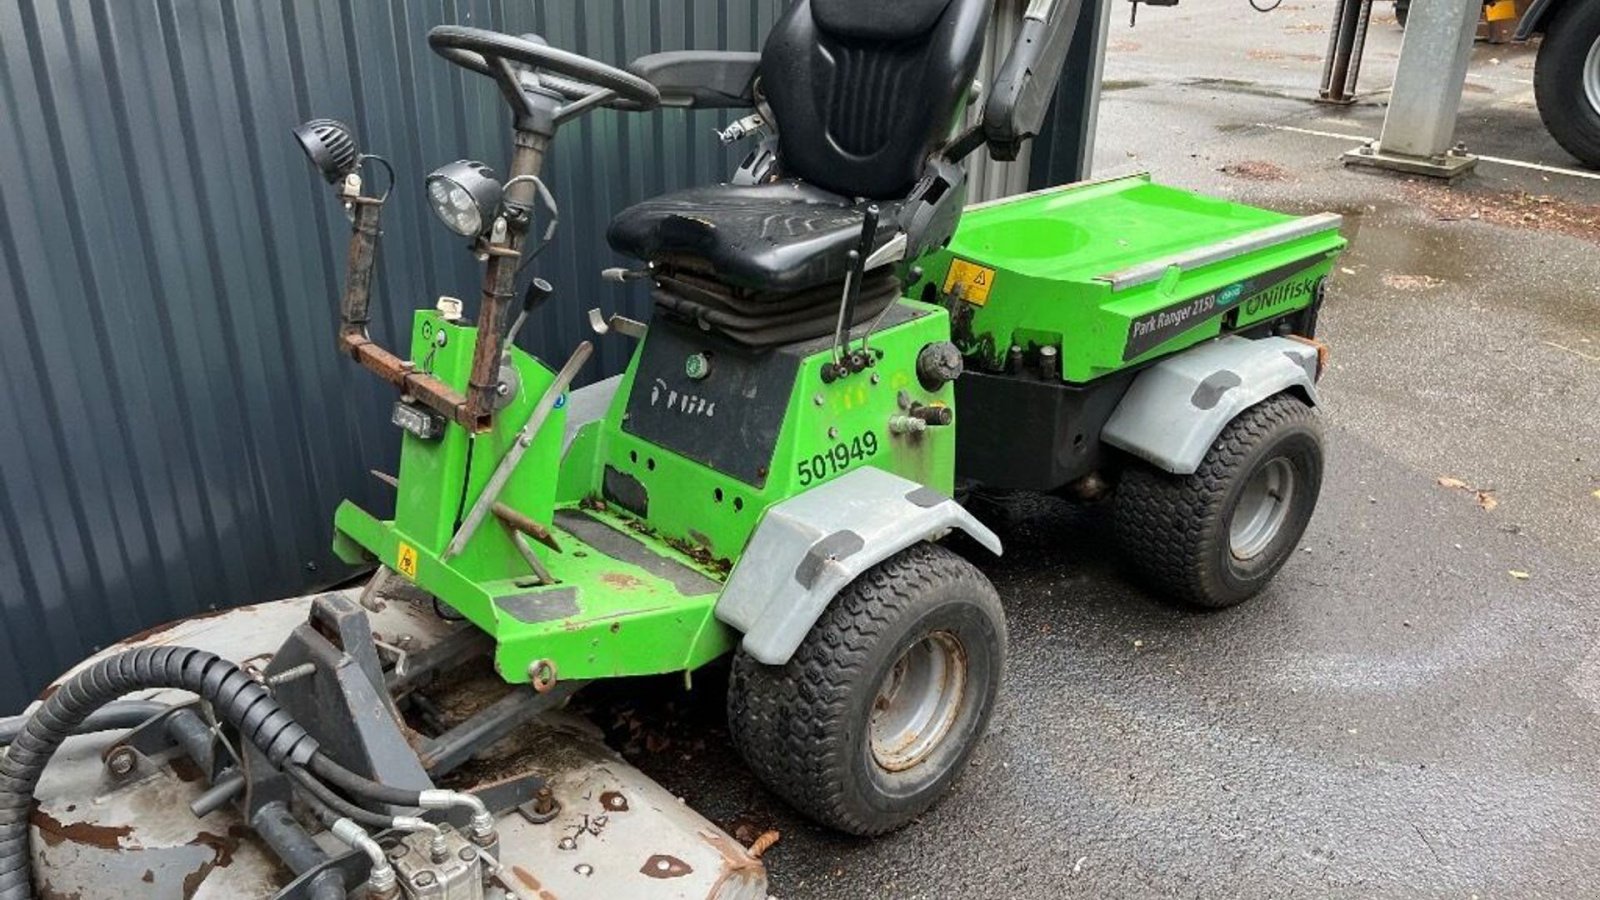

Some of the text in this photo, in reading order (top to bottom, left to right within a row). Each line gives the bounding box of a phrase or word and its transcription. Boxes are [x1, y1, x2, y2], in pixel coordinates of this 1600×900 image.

[1261, 279, 1313, 310] Nilfisk
[1133, 295, 1216, 338] Park Ranger 2150
[798, 430, 877, 486] 501949
